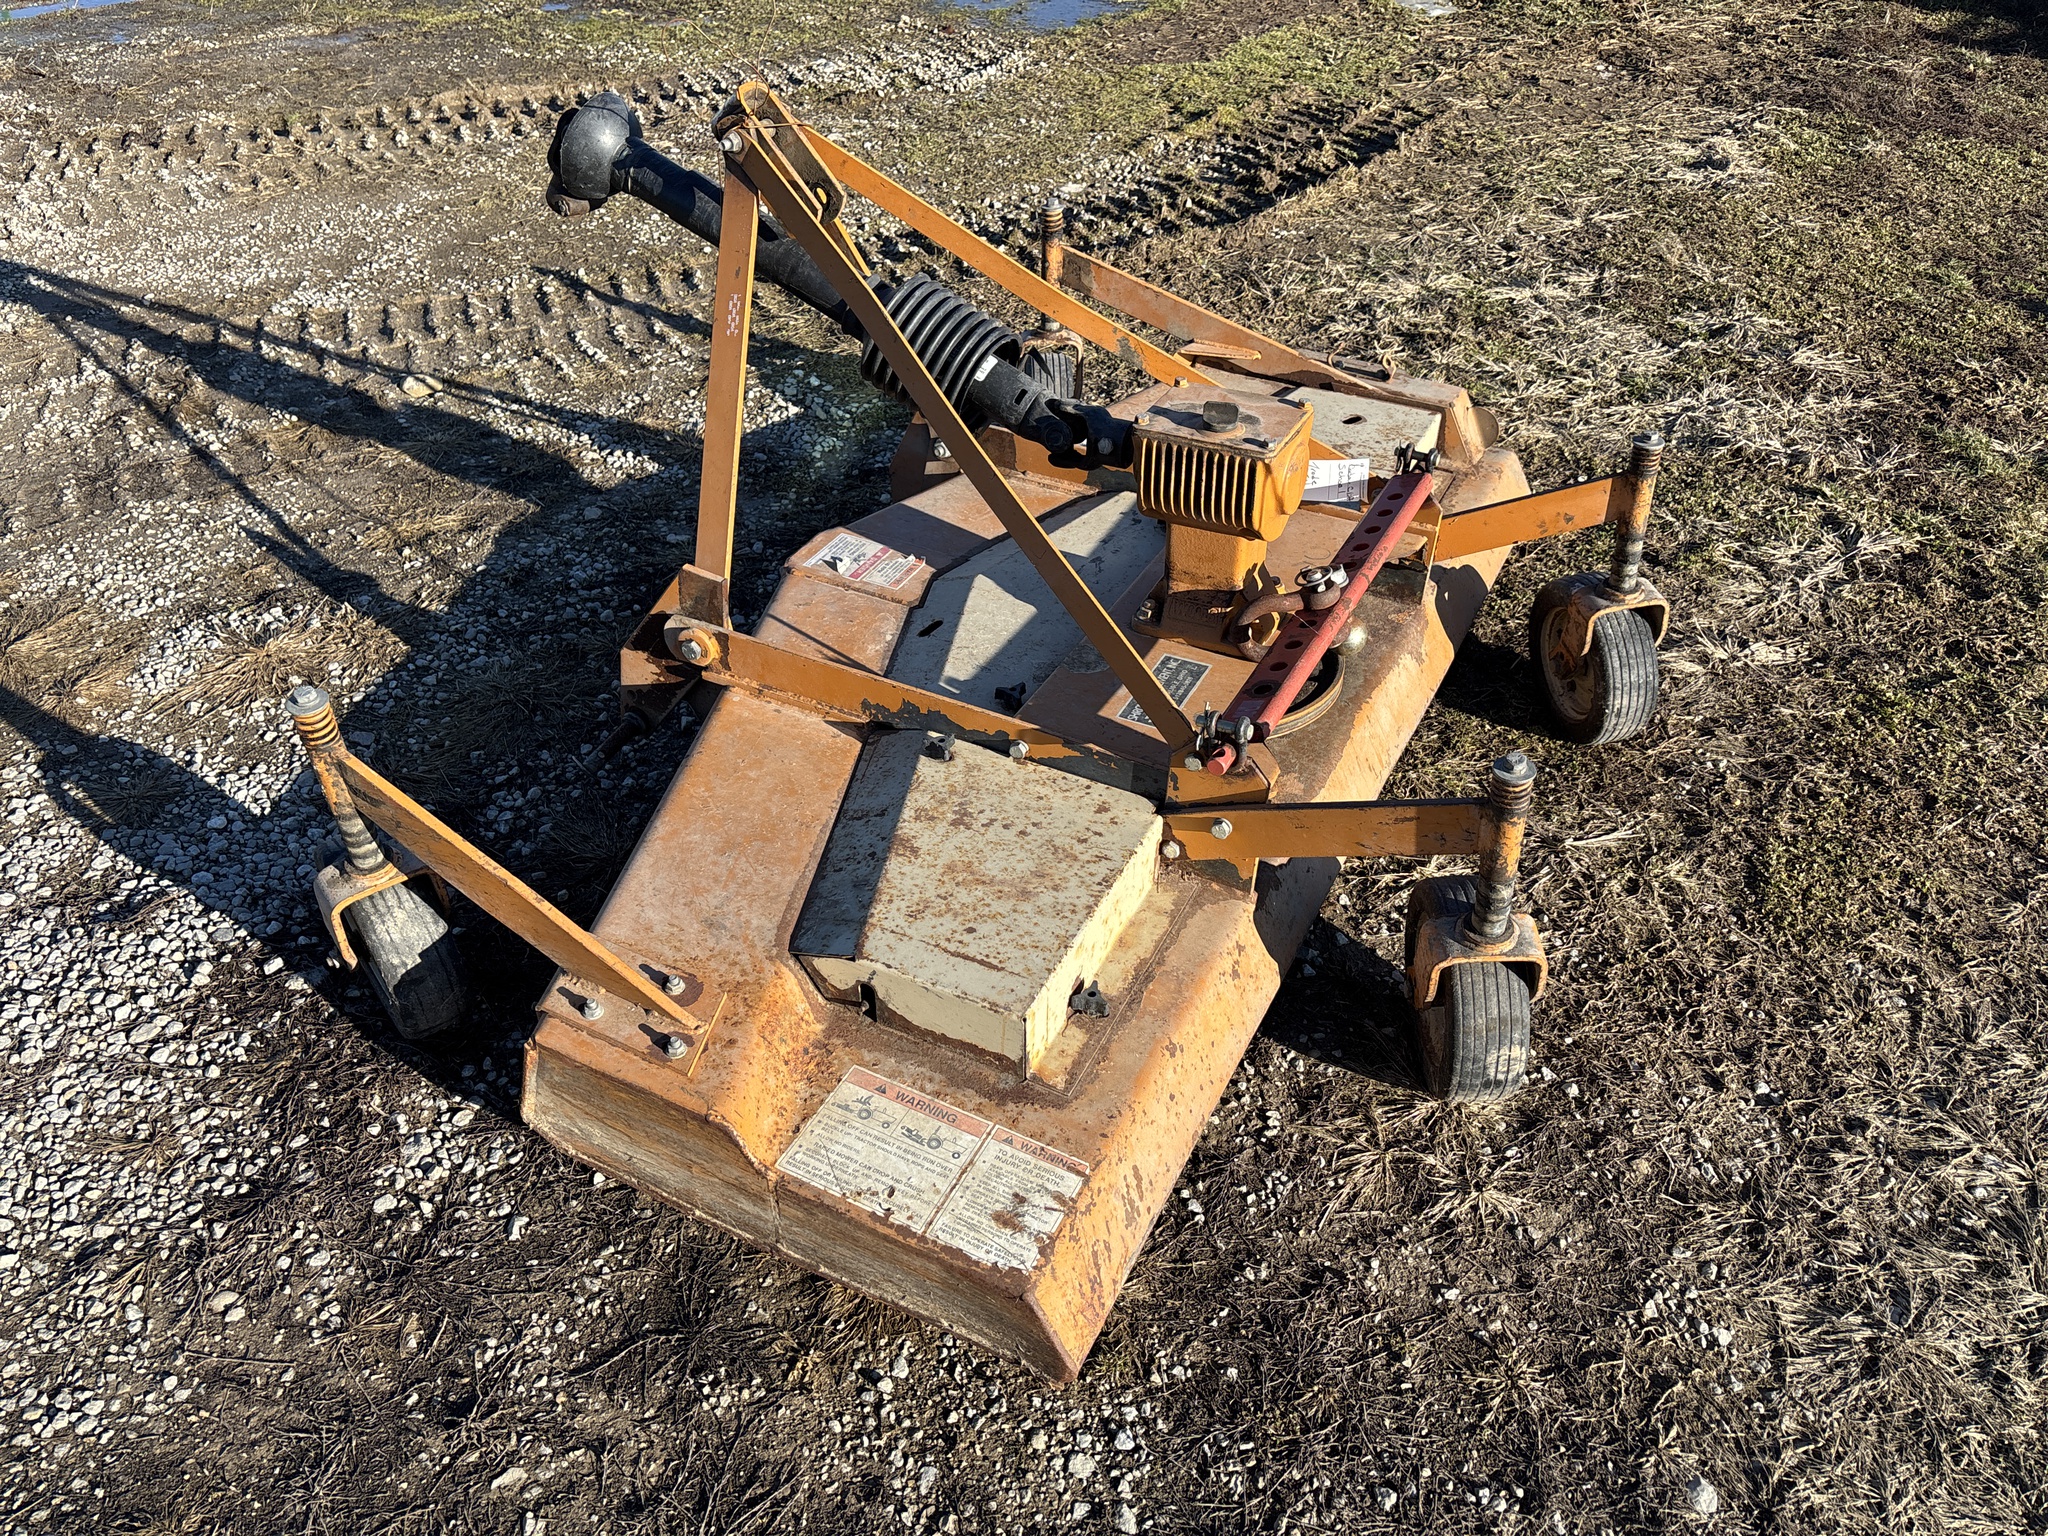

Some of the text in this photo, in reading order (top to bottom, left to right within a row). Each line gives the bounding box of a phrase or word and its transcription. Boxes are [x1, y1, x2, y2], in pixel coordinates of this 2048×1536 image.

[893, 1090, 959, 1124] WARNING
[822, 1113, 847, 1127] FALLING
[846, 1124, 859, 1132] OFF
[858, 1129, 873, 1138] CAN
[871, 1135, 896, 1148] RESULT
[902, 1147, 922, 1159] BEING
[921, 1156, 936, 1165] RUN
[934, 1162, 953, 1173] OVER
[823, 1122, 843, 1133] BUCKLE
[853, 1135, 877, 1148] TRACTOR
[875, 1145, 897, 1157] SHOULD
[896, 1153, 910, 1162] HAVE
[909, 1159, 925, 1169] ROPS
[924, 1166, 936, 1174] AND
[935, 1171, 949, 1179] SEAT
[784, 1159, 805, 1172] RESULT
[810, 1171, 835, 1186] SERIOUS
[812, 1141, 925, 1194] RAISED MOWER CAN DROP AND CRUSH
[993, 1154, 1022, 1170] INJURY
[1021, 1166, 1034, 1175] OR
[996, 1148, 1066, 1181] TO AVOID SERIOUS
[810, 1165, 822, 1173] OFF
[881, 1197, 910, 1213] SECURELY
[910, 1210, 924, 1219] CAN
[831, 1159, 850, 1170] BLOCK
[850, 1167, 861, 1175] UP
[860, 1172, 872, 1180] AND
[909, 1193, 932, 1206] BEFORE
[937, 1226, 959, 1238] RESULT
[940, 1222, 963, 1234] FAILURE
[969, 1235, 994, 1248] OPERATE
[957, 1212, 975, 1221] ALLOW
[984, 1223, 1009, 1236] CHILDREN
[1008, 1240, 1032, 1252] OPERATE
